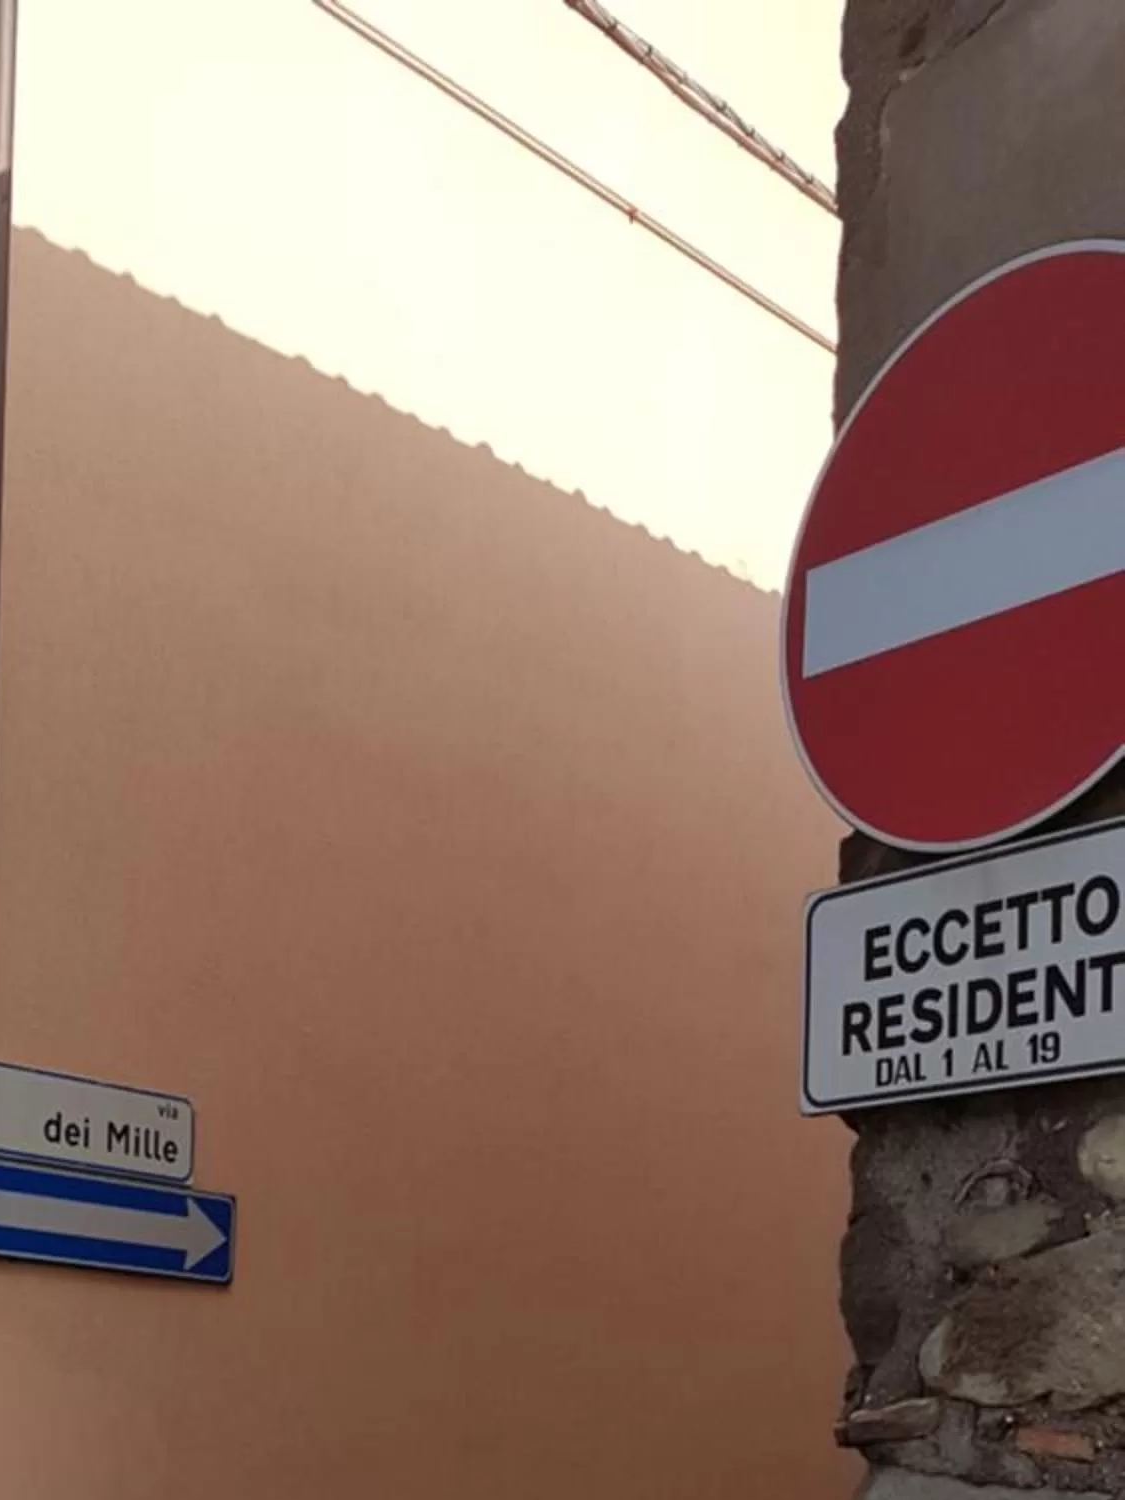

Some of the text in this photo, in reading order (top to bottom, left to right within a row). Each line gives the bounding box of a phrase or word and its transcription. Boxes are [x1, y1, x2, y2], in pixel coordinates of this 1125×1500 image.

[864, 875, 1120, 981] ECCETTO
[842, 951, 1125, 1056] RESIDENT
[876, 1032, 1062, 1087] DAL 1 AL 19
[43, 1111, 179, 1163] dei Mille
[157, 1104, 178, 1120] via
